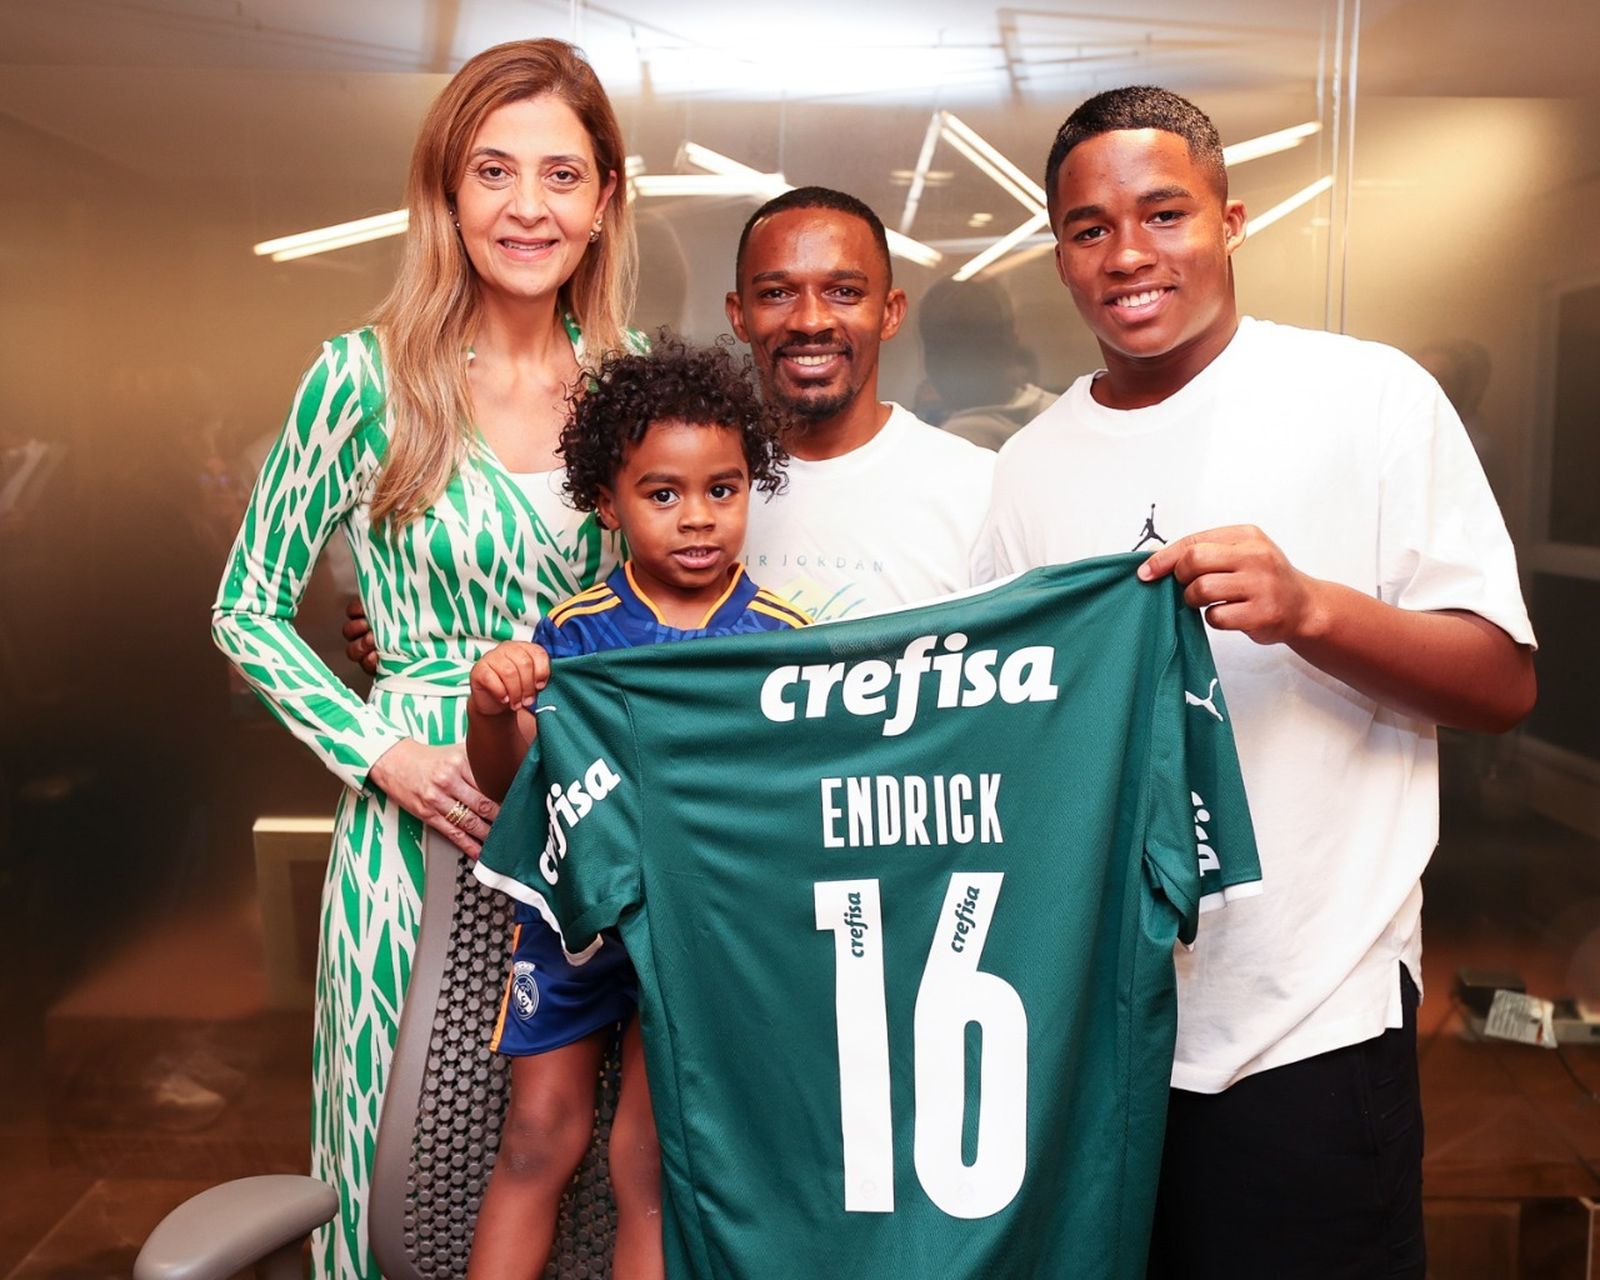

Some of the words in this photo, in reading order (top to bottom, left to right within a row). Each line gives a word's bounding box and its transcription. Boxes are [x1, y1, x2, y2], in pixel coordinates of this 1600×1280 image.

[745, 554, 768, 567] IR
[782, 554, 884, 573] JORDAN
[760, 632, 1058, 737] crefisa
[821, 773, 1004, 848] ENDRICK
[844, 892, 868, 958] crefisa
[951, 886, 980, 953] crefisa
[813, 872, 1028, 1219] 16
